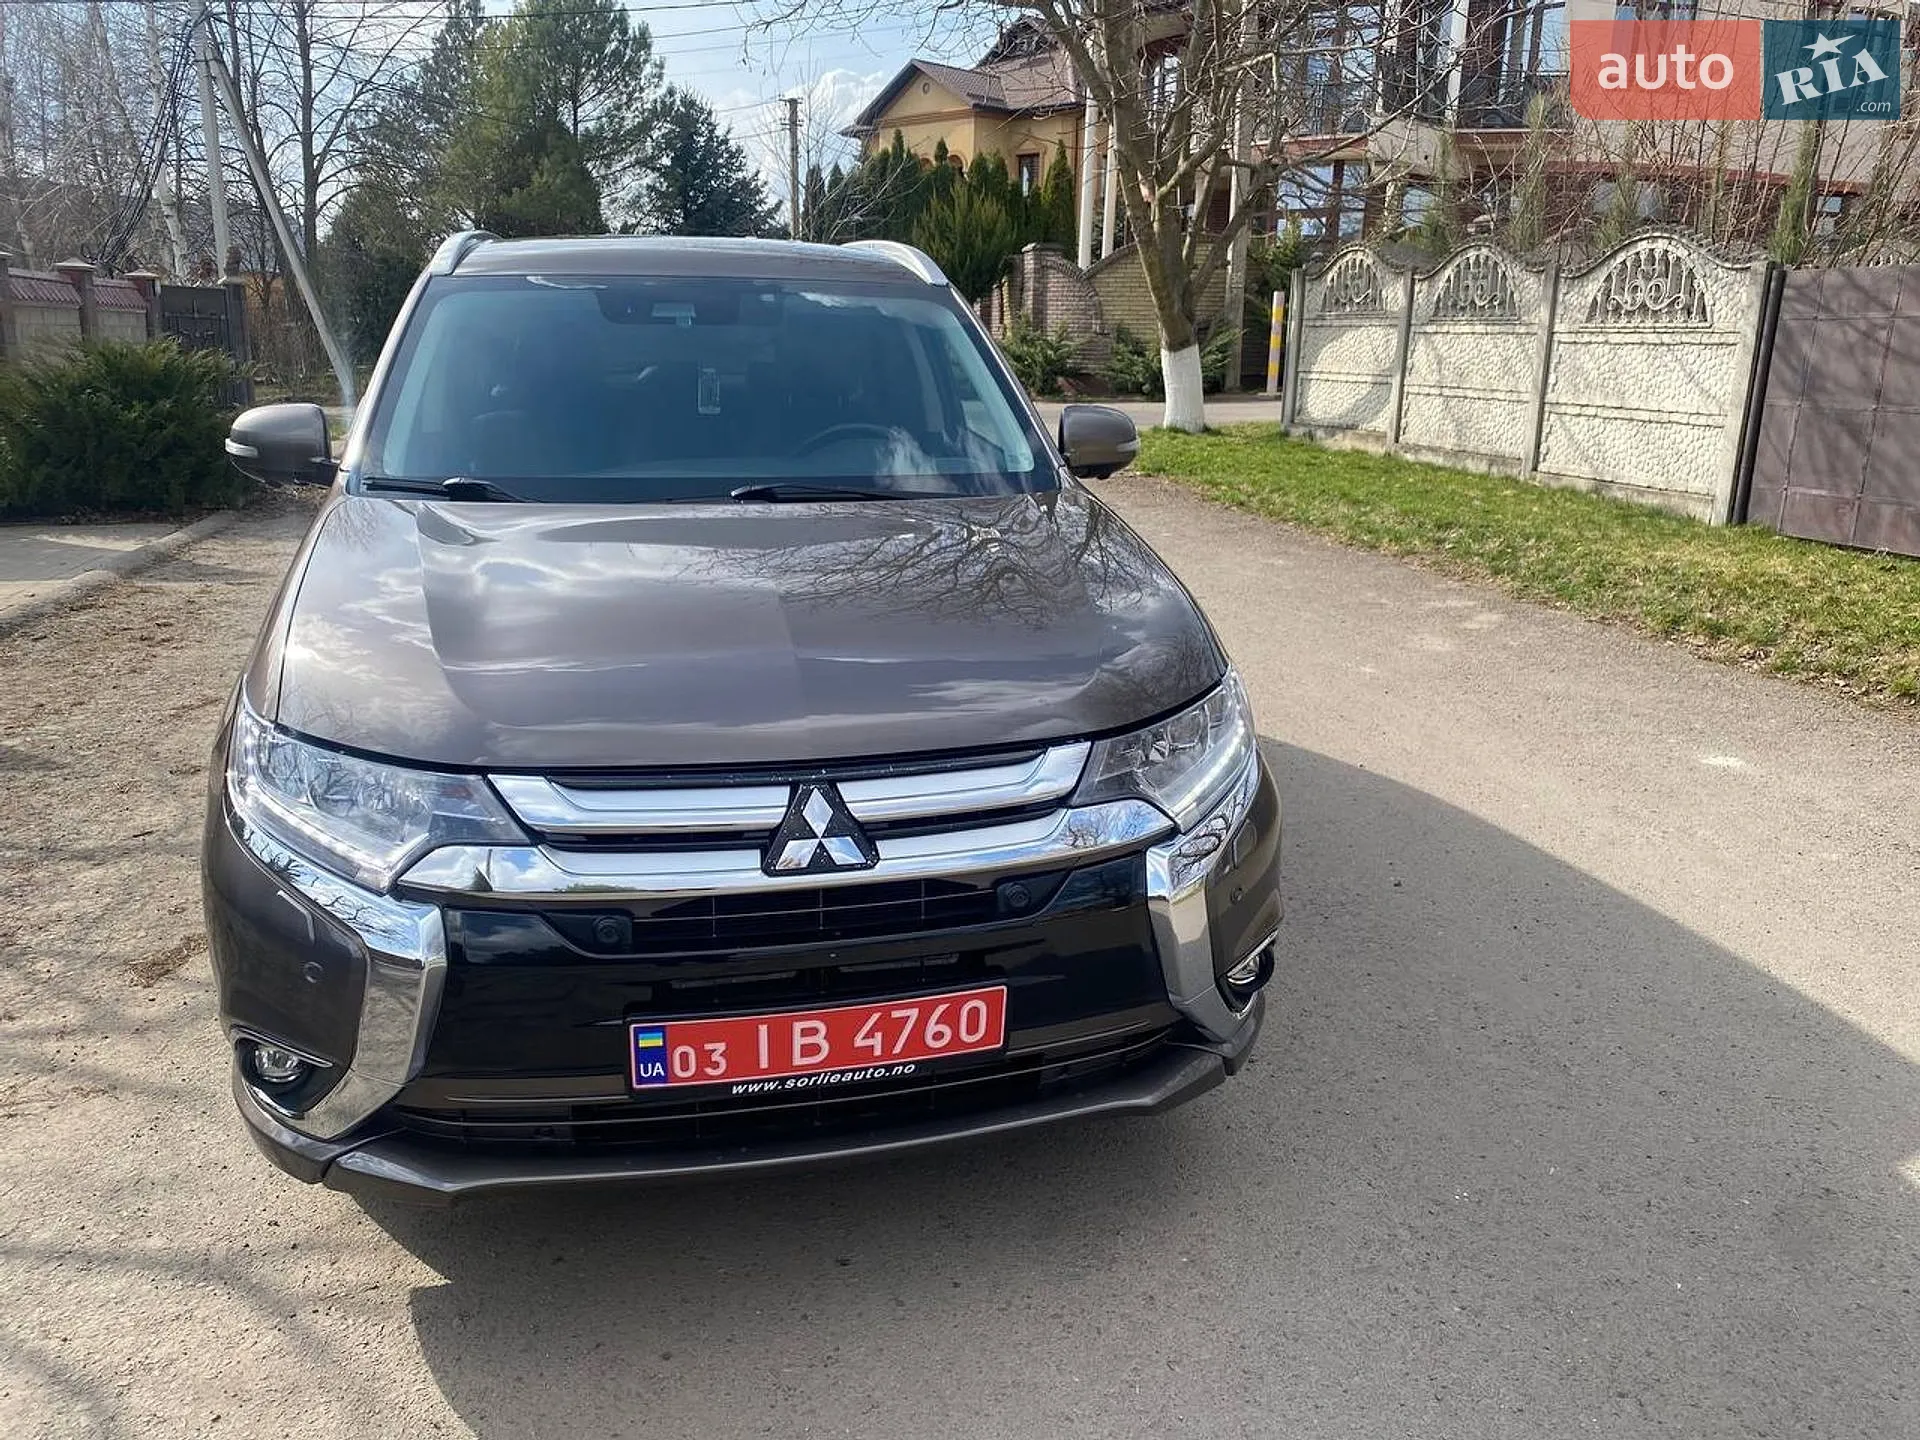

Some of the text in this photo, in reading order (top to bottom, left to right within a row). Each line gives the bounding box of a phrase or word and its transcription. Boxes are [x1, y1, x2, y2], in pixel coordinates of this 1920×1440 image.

[672, 999, 988, 1079] 03 IB 4760
[640, 1062, 665, 1078] UA
[731, 1062, 916, 1096] www.sorlieauto.no
